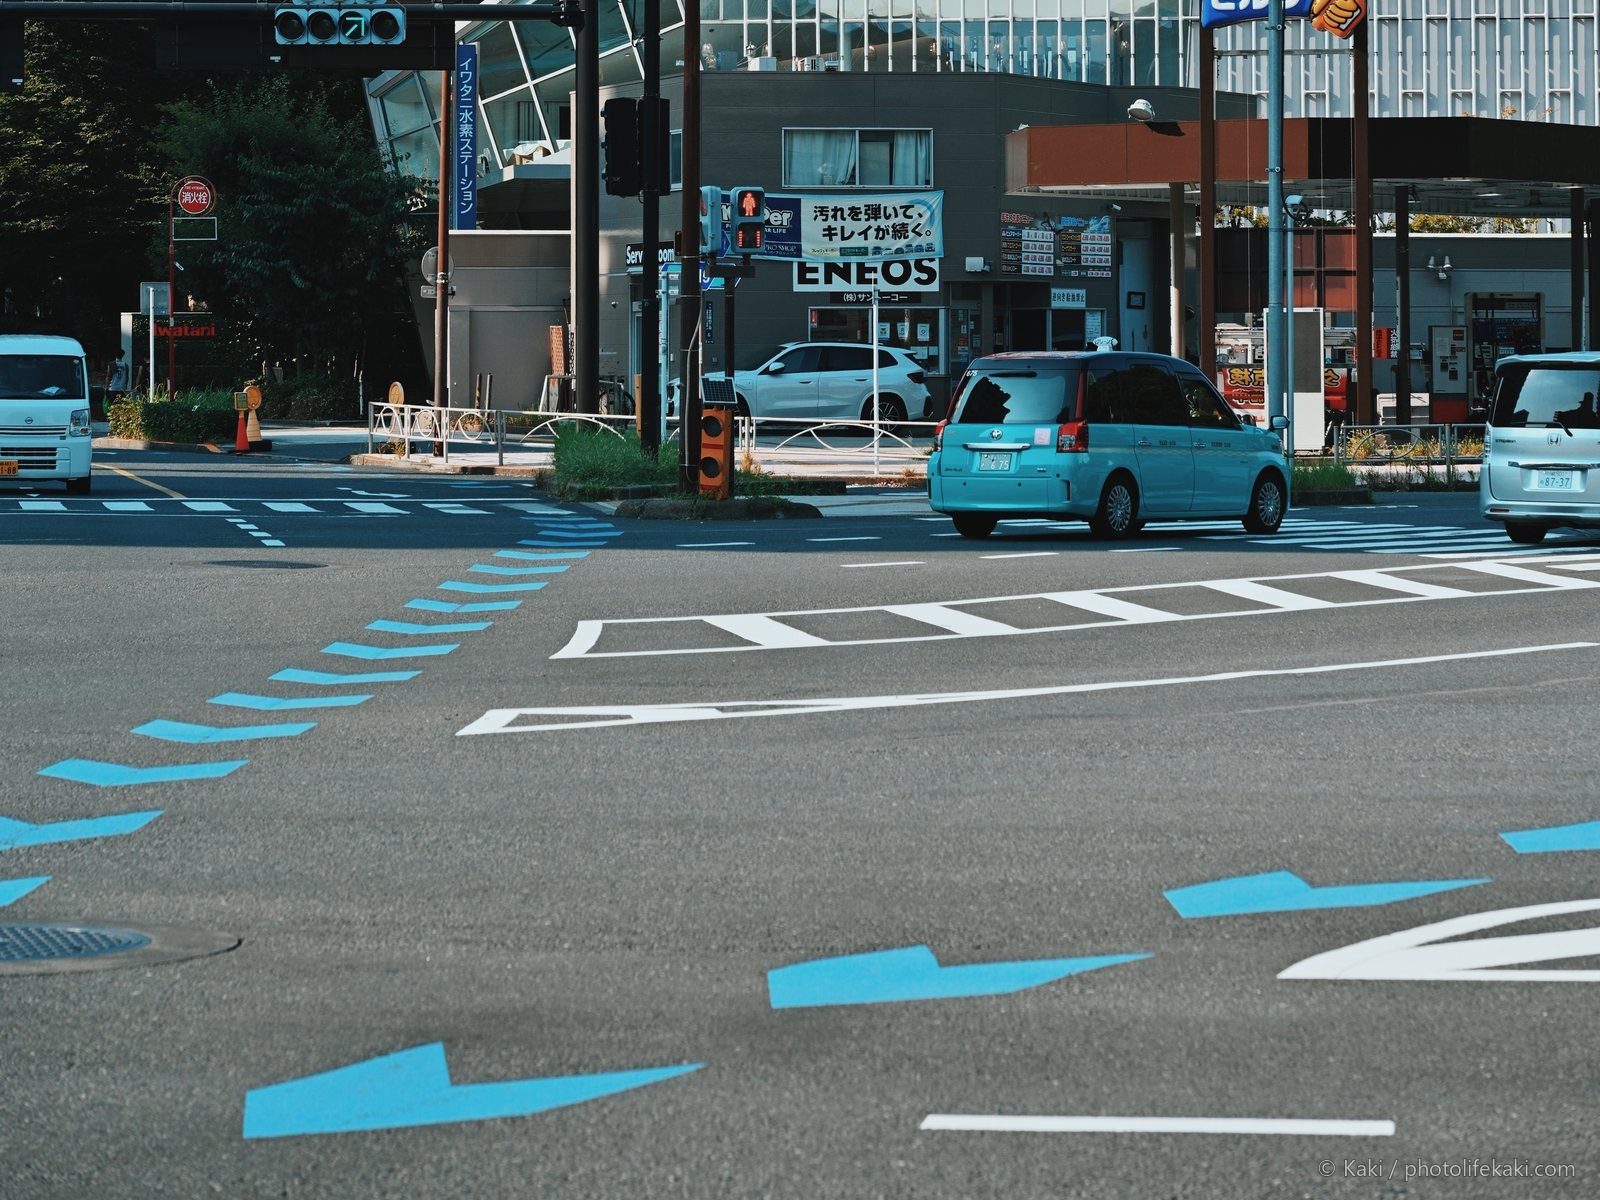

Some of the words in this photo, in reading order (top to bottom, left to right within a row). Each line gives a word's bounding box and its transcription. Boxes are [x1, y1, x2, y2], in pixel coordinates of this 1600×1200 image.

[459, 57, 474, 214] イワタニ水素ステーション
[182, 191, 208, 204] 消火栓
[813, 203, 924, 222] 汚れを弾いて、
[822, 222, 932, 241] キレイが続く。
[797, 259, 937, 286] ENEOS
[843, 293, 908, 302] (株)サンーコー
[1544, 477, 1570, 487] 87-37
